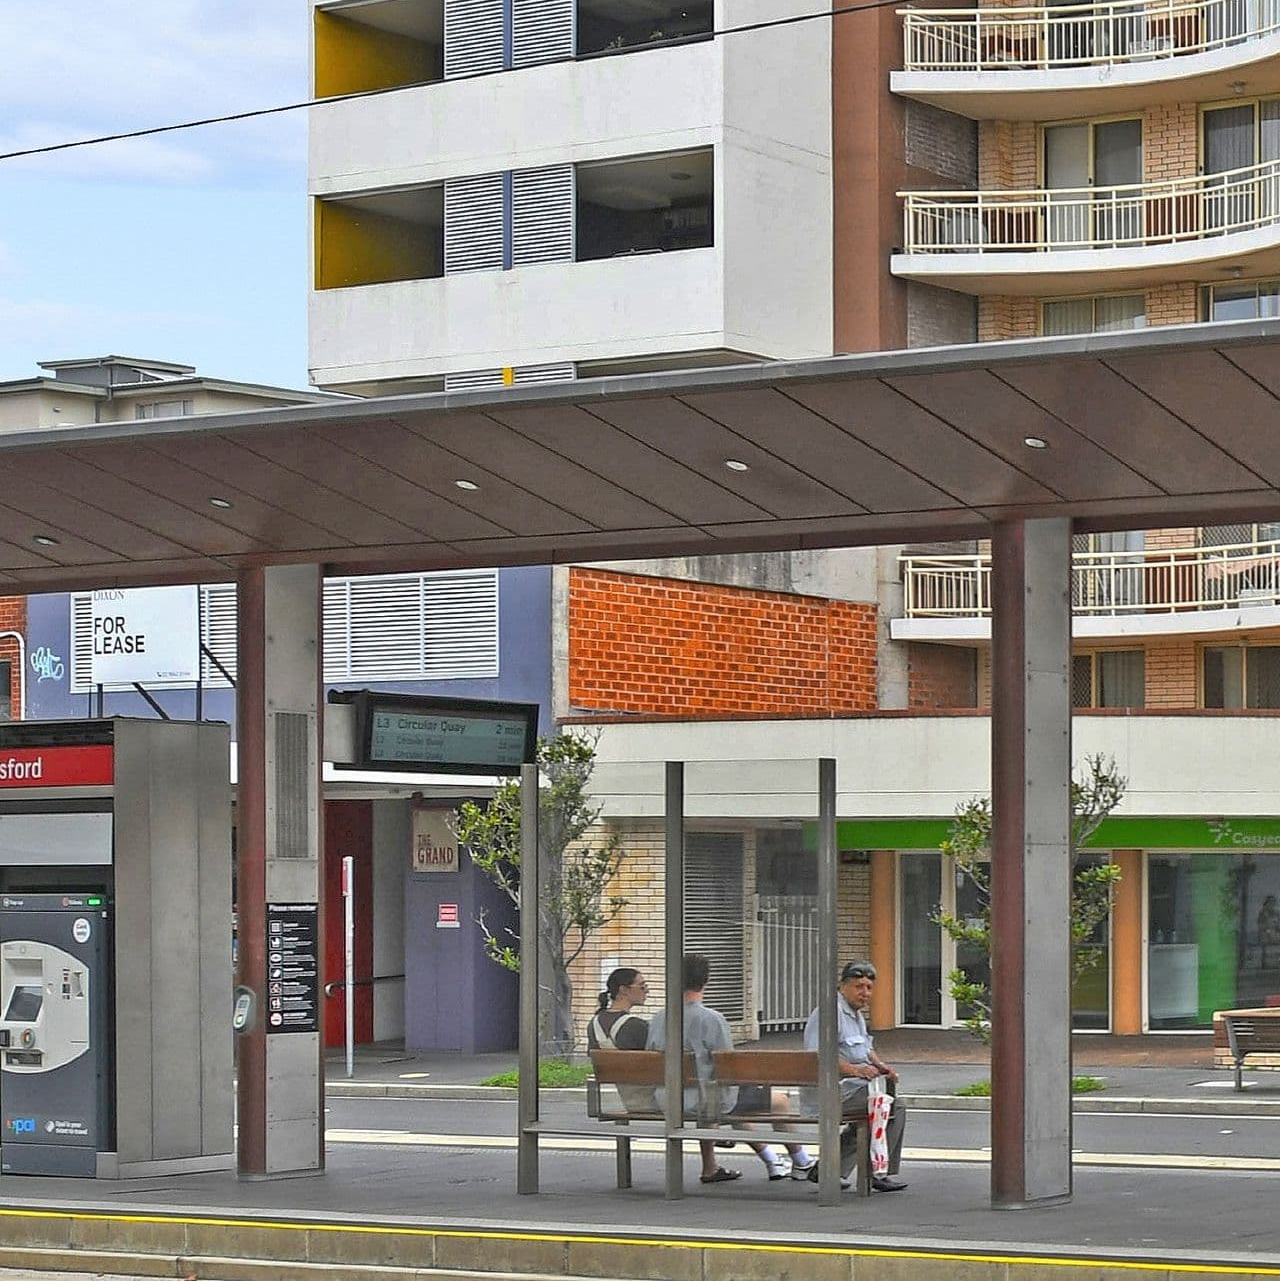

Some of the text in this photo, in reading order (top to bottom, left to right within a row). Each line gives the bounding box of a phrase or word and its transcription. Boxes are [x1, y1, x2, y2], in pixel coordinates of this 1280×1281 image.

[93, 616, 126, 635] FOR
[93, 635, 146, 655] LEASE
[376, 718, 390, 729] L3
[397, 719, 438, 731] Circular
[440, 721, 467, 735] Quay
[495, 724, 502, 735] 2
[417, 847, 454, 865] GRAND
